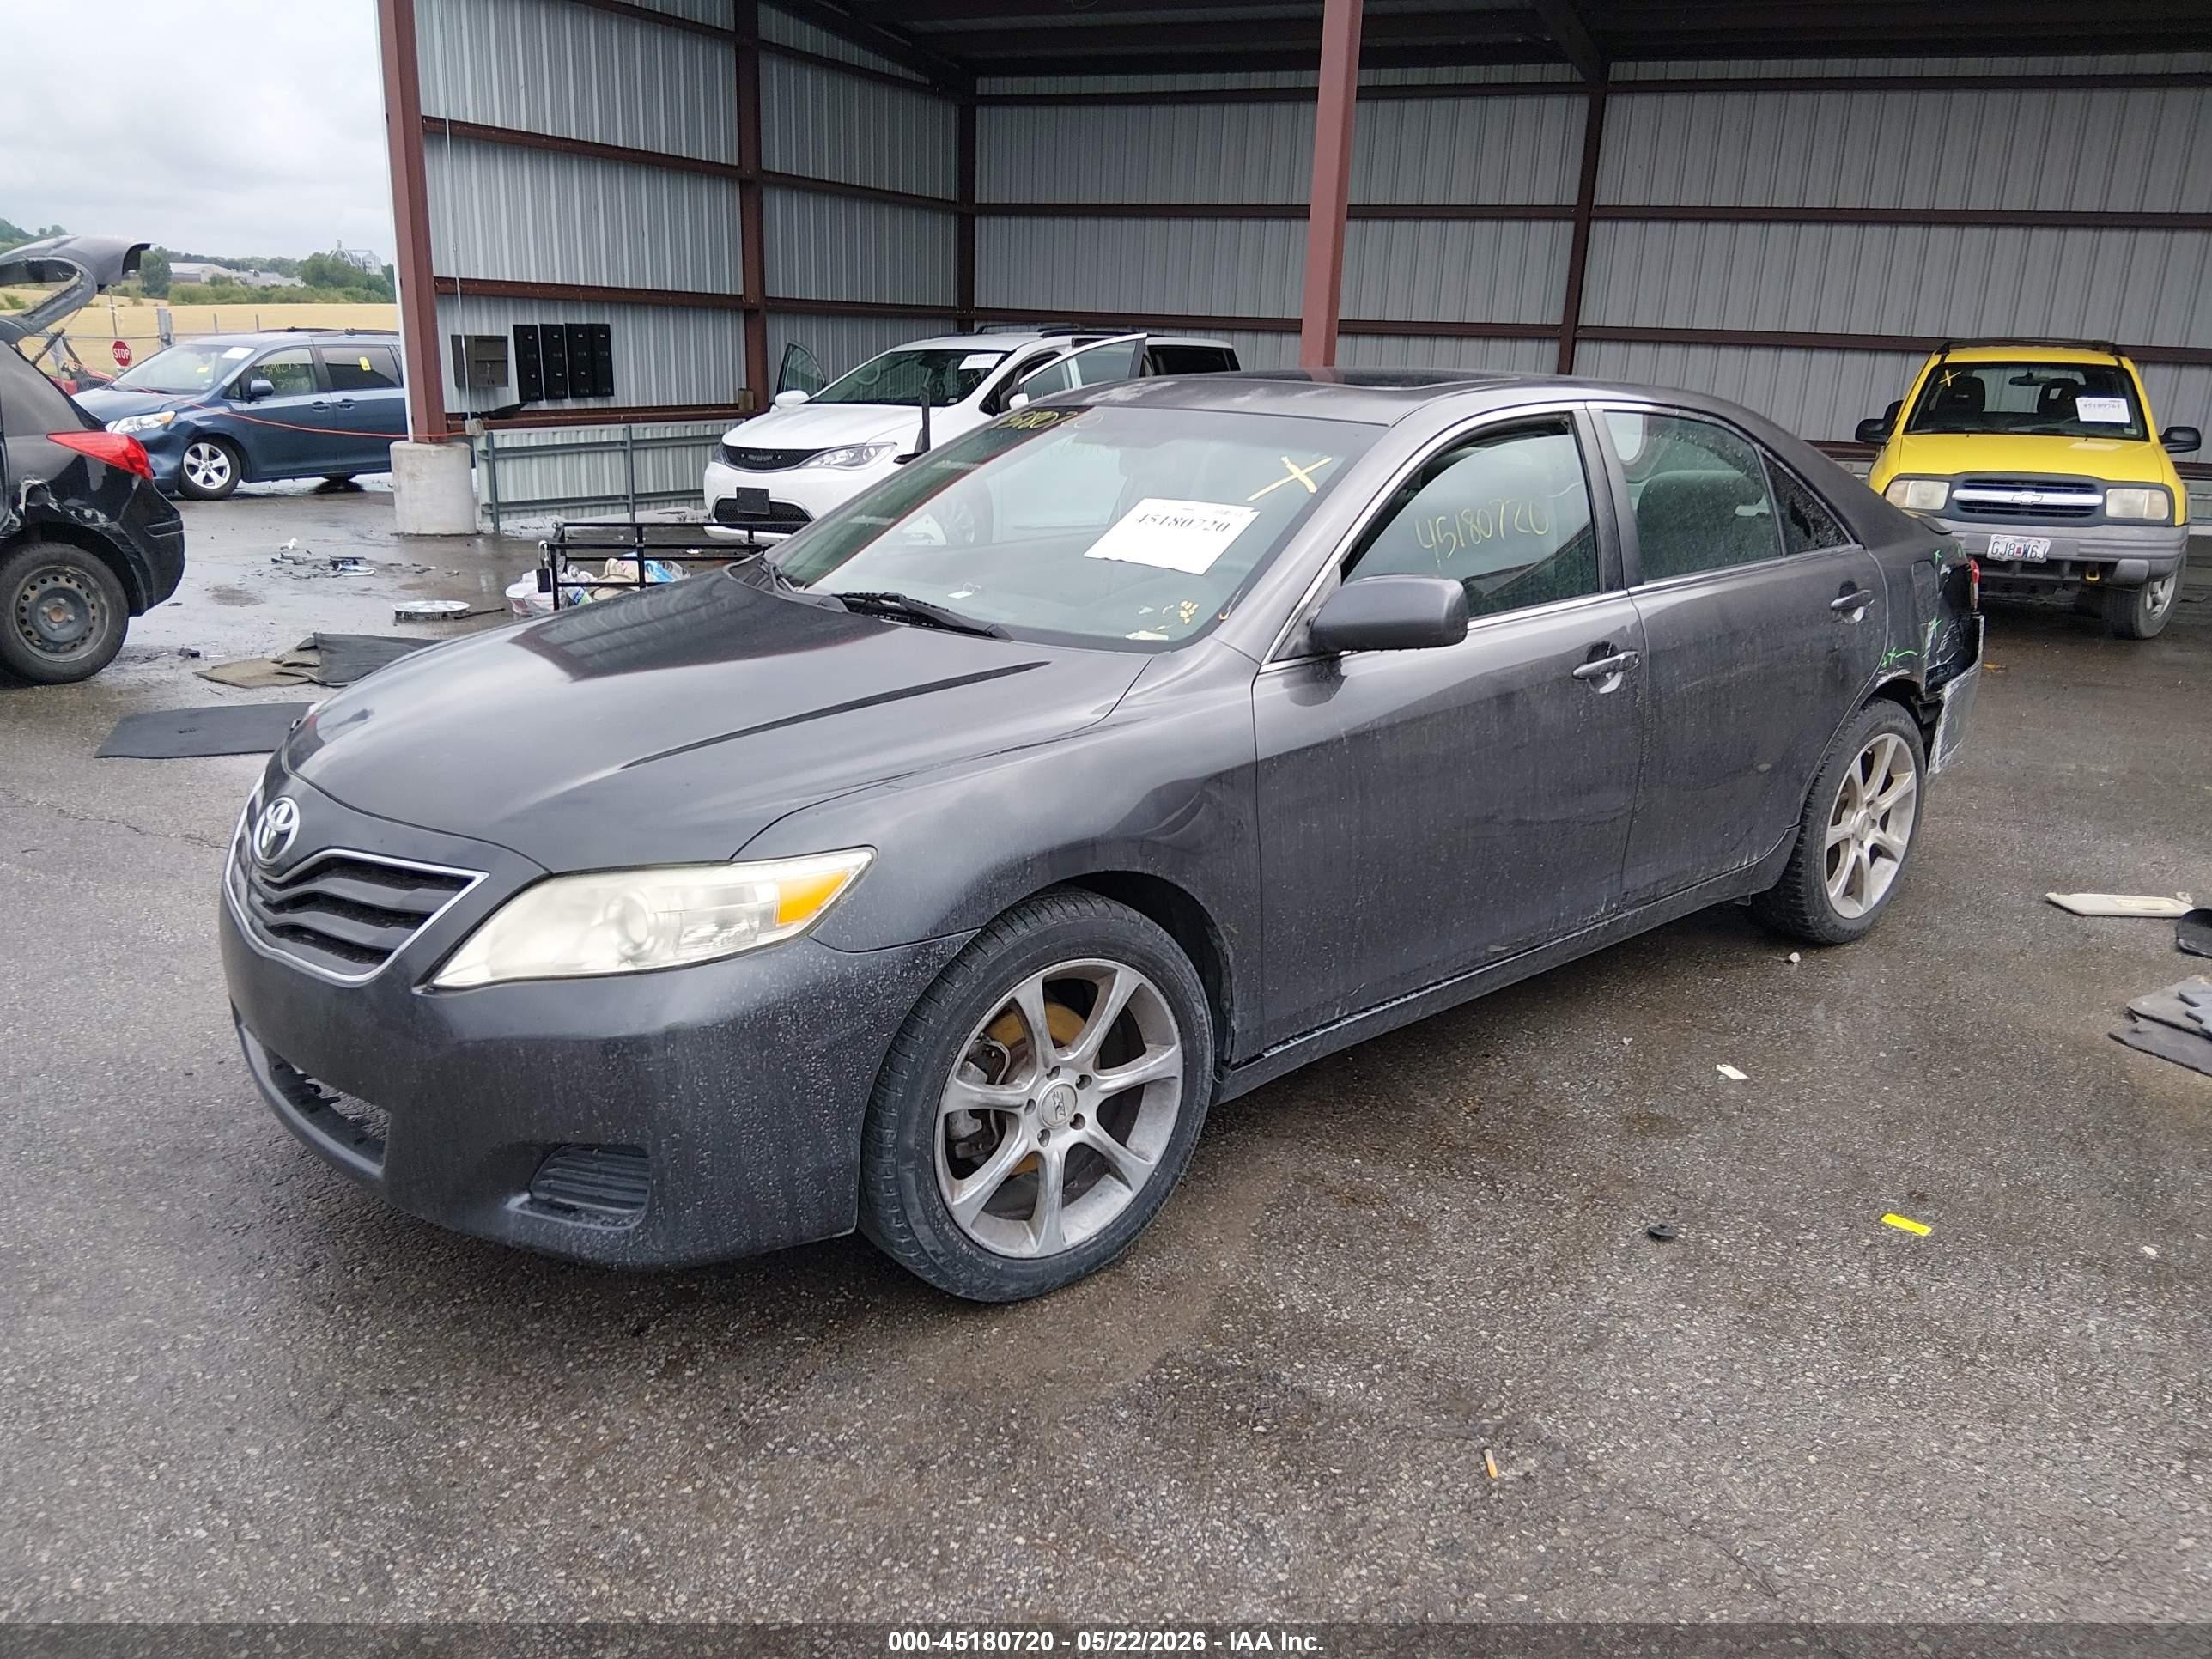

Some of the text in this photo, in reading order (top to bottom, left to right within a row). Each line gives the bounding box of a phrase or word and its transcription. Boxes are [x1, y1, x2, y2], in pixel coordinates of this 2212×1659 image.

[113, 347, 130, 360] STOP
[1136, 514, 1231, 533] 45180720
[1415, 498, 1549, 565] 45180720
